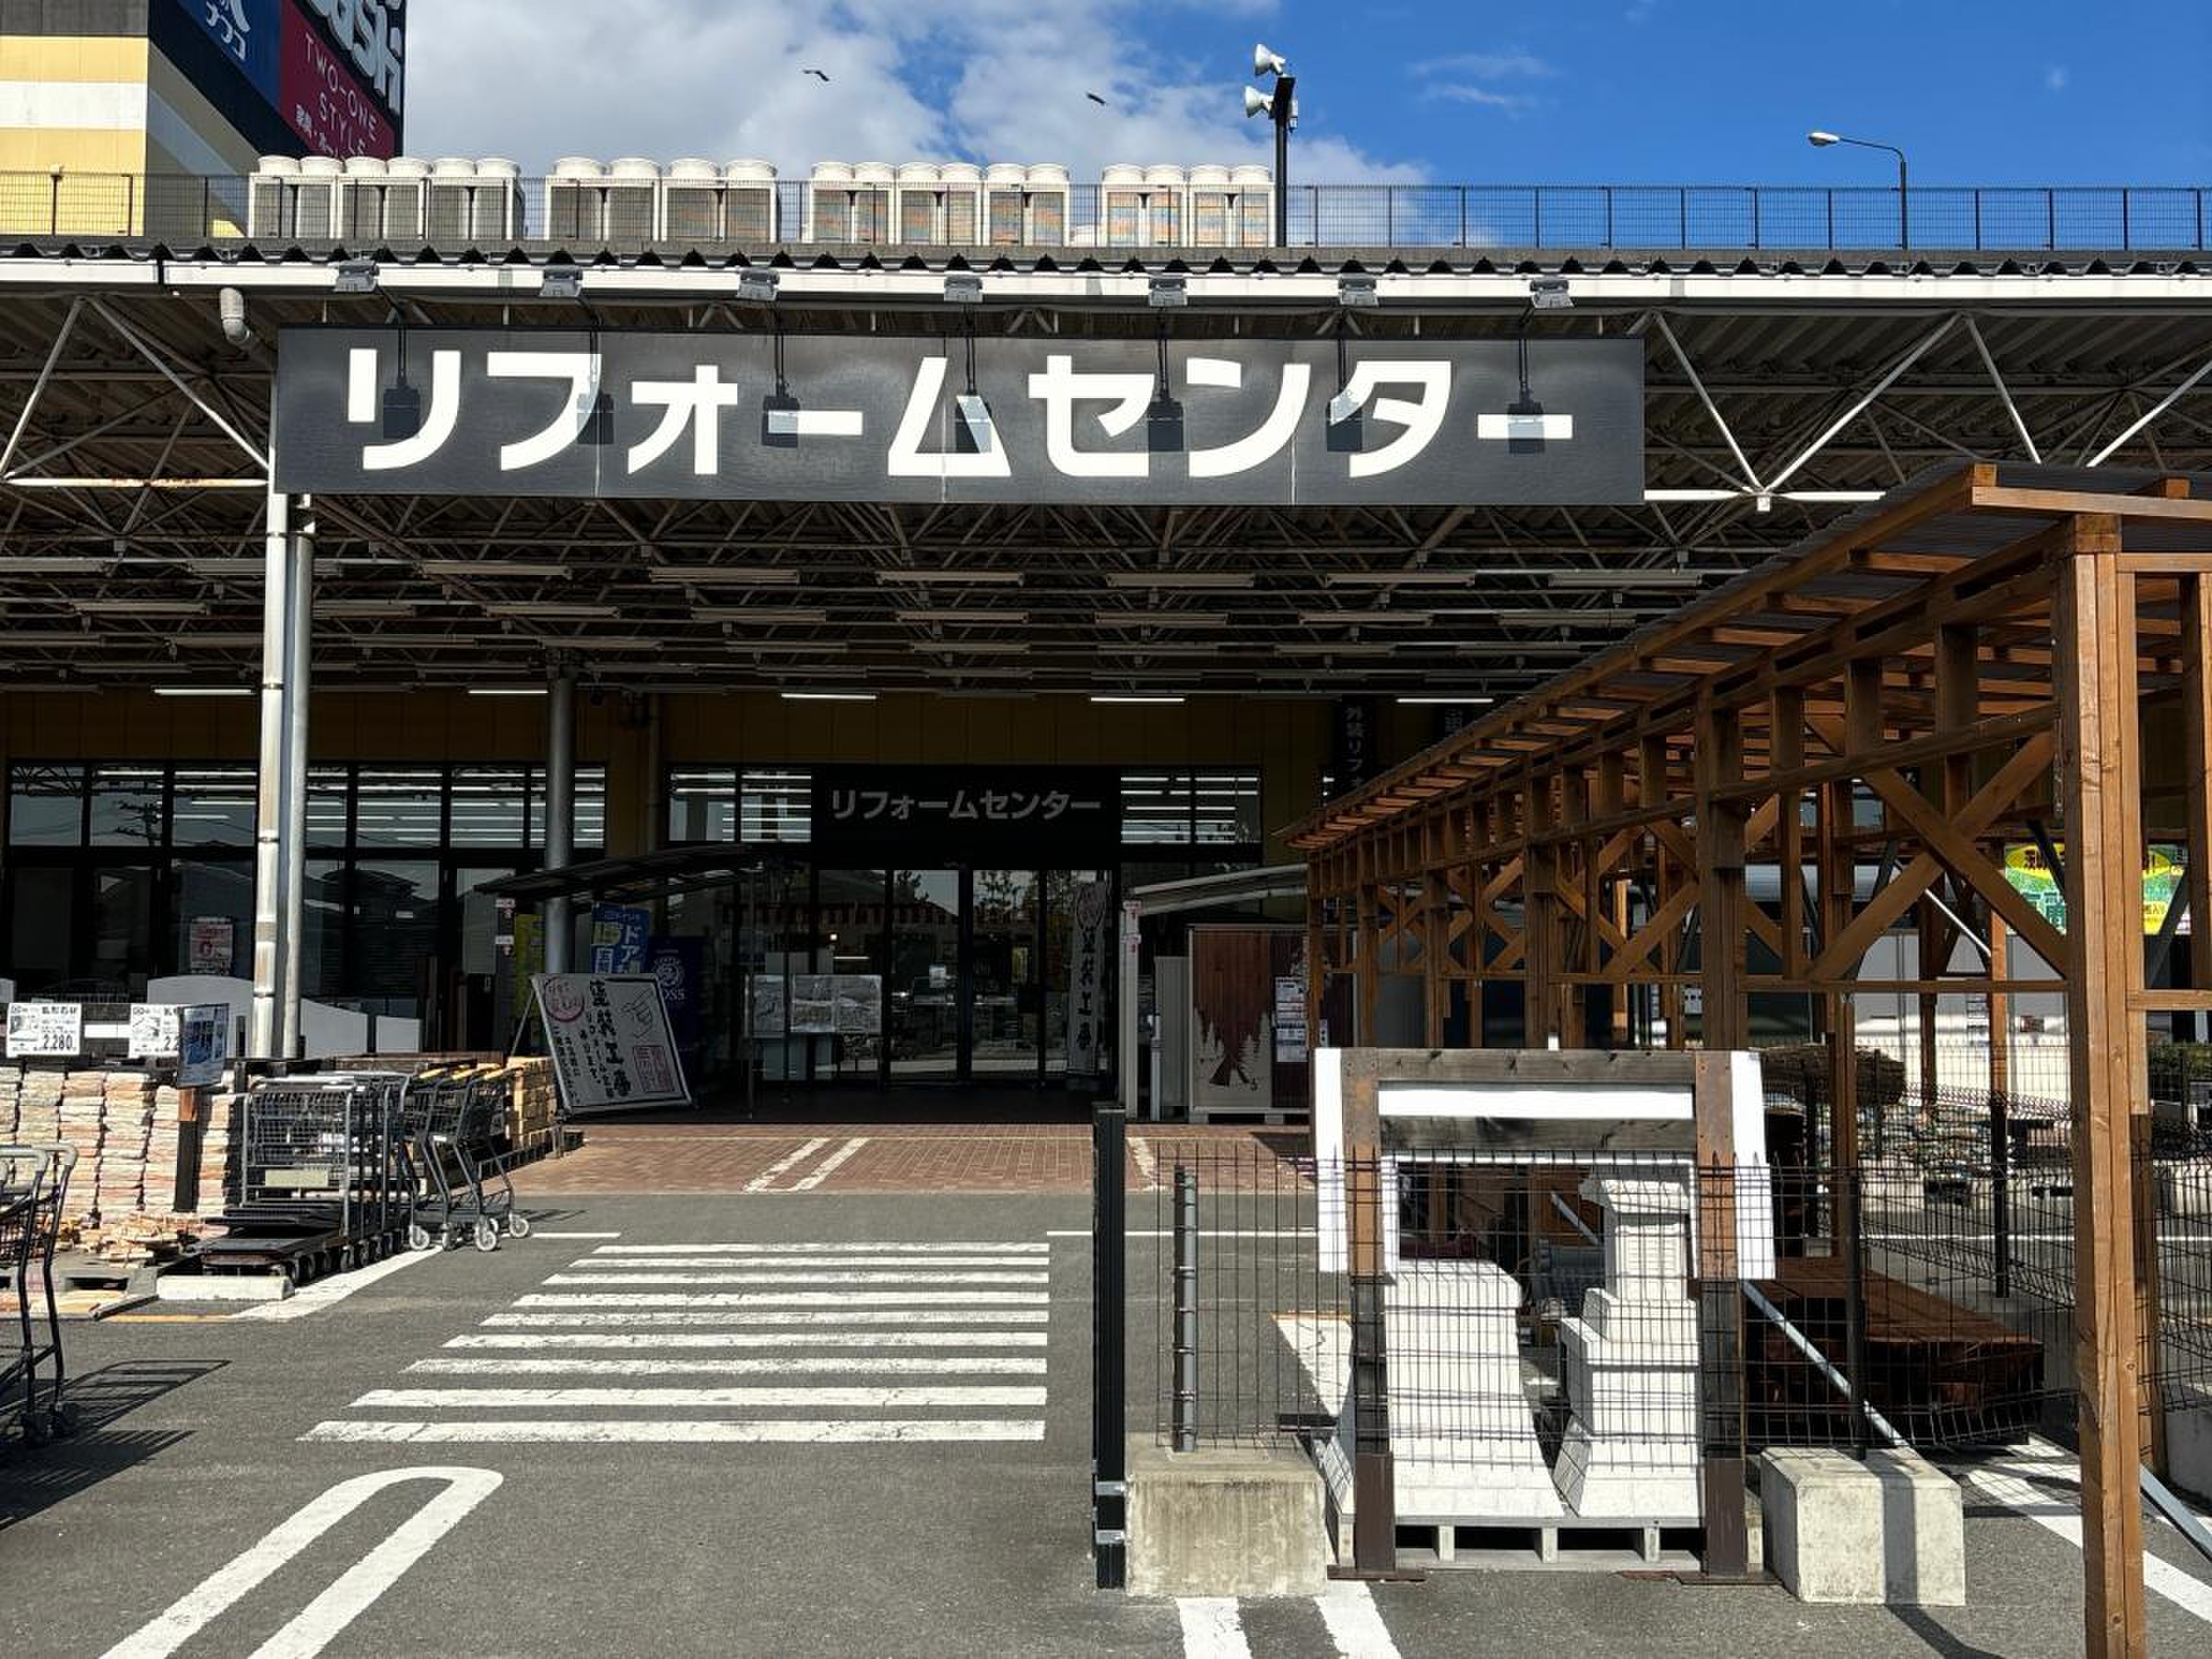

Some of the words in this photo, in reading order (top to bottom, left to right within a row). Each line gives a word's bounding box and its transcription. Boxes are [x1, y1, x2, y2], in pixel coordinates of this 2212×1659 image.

[305, 32, 377, 142] TWO-ONE
[347, 347, 1573, 478] リフォームセンター
[831, 789, 1102, 820] リフォームセンター
